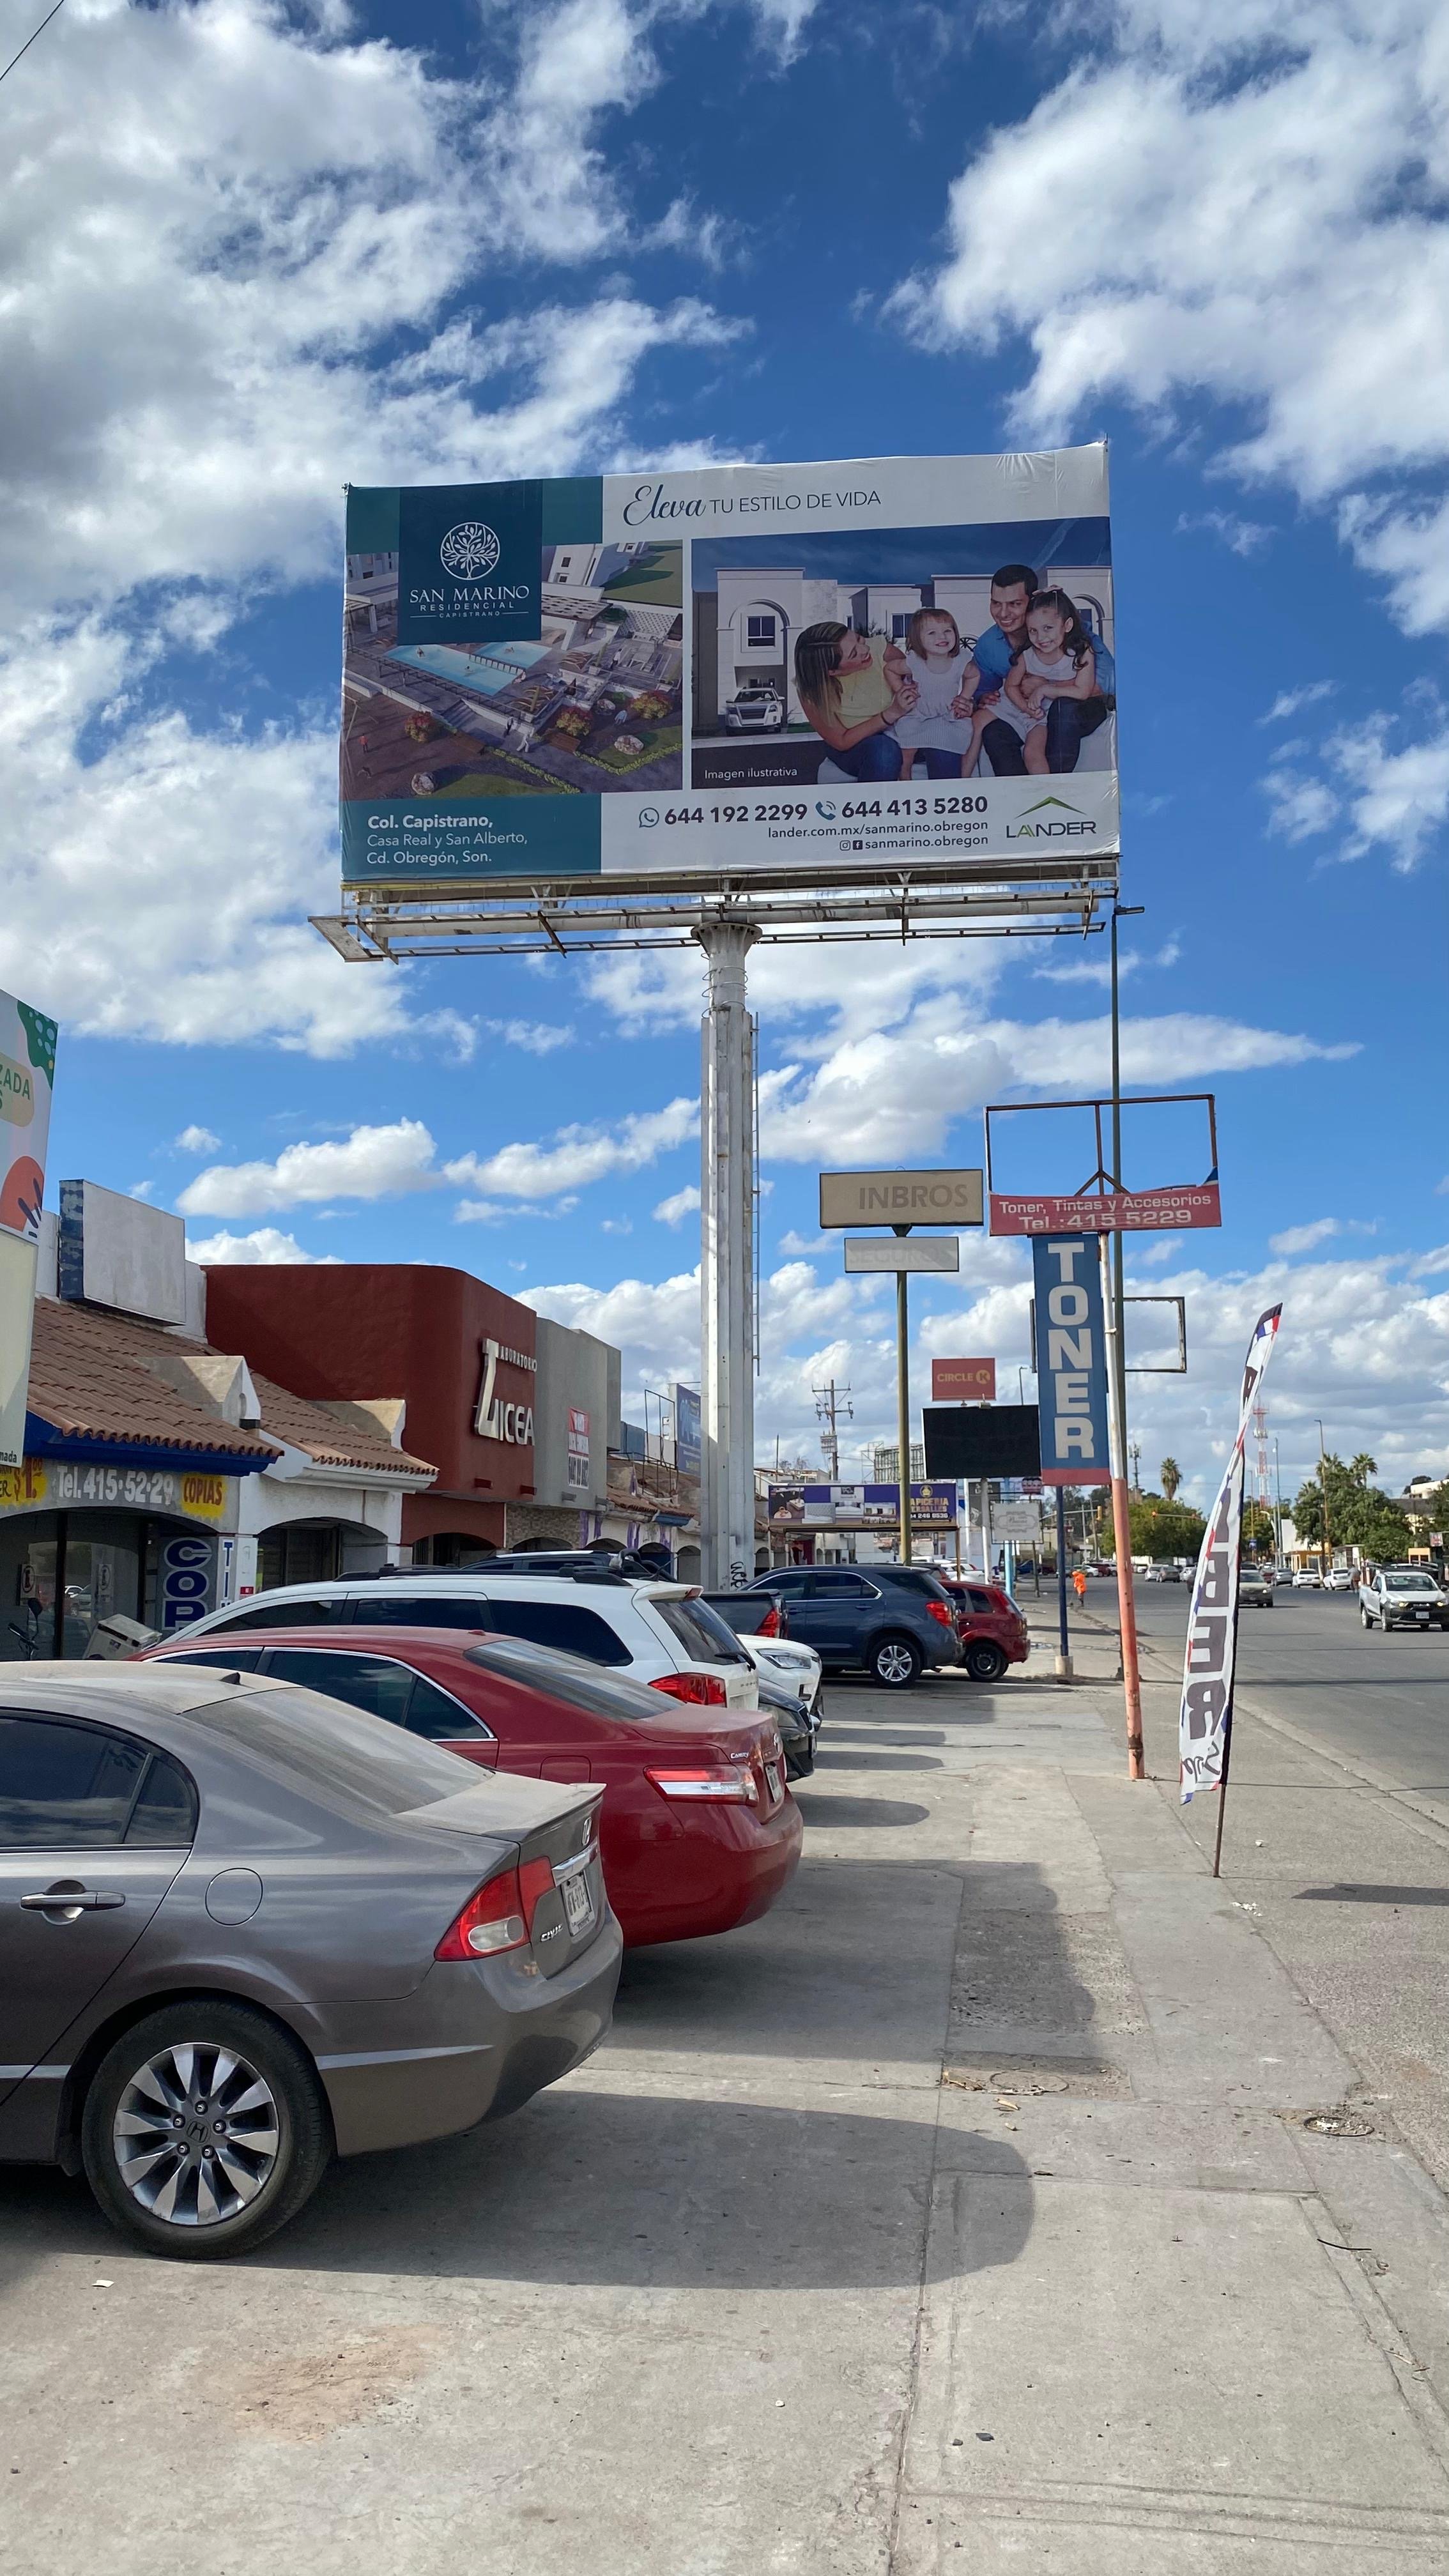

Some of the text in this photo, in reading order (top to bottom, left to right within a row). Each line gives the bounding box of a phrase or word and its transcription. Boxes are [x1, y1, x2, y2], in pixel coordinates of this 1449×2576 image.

[623, 484, 881, 526] Eleva TU ESTILO DE VIDA
[410, 585, 530, 603] SAN MARINO
[420, 601, 514, 611] RESIDENCIAL
[705, 767, 798, 781] Imagen ilustrativa
[664, 803, 808, 825] 644 192 2299
[841, 796, 988, 818] 644 413 5280
[367, 813, 493, 831] Col. Capistrano,
[768, 820, 988, 838] lander.com.mx/sanmarino.obregon
[1006, 821, 1097, 839] LANDER
[367, 831, 528, 849] Casa Real y San Alberto,
[864, 835, 988, 850] sanmarino.obregon
[367, 850, 492, 866] Cd. Obregón, Son.
[859, 1183, 969, 1209] INBROS
[999, 1193, 1211, 1214] Toner, Tintas y Accesorios
[1126, 1209, 1192, 1225] 5229
[1048, 1241, 1094, 1459] TONER
[937, 1369, 991, 1385] CIRCLE K
[183, 1477, 223, 1506] COPIAS
[910, 1498, 949, 1506] APICERIA
[162, 1538, 213, 1631] COP
